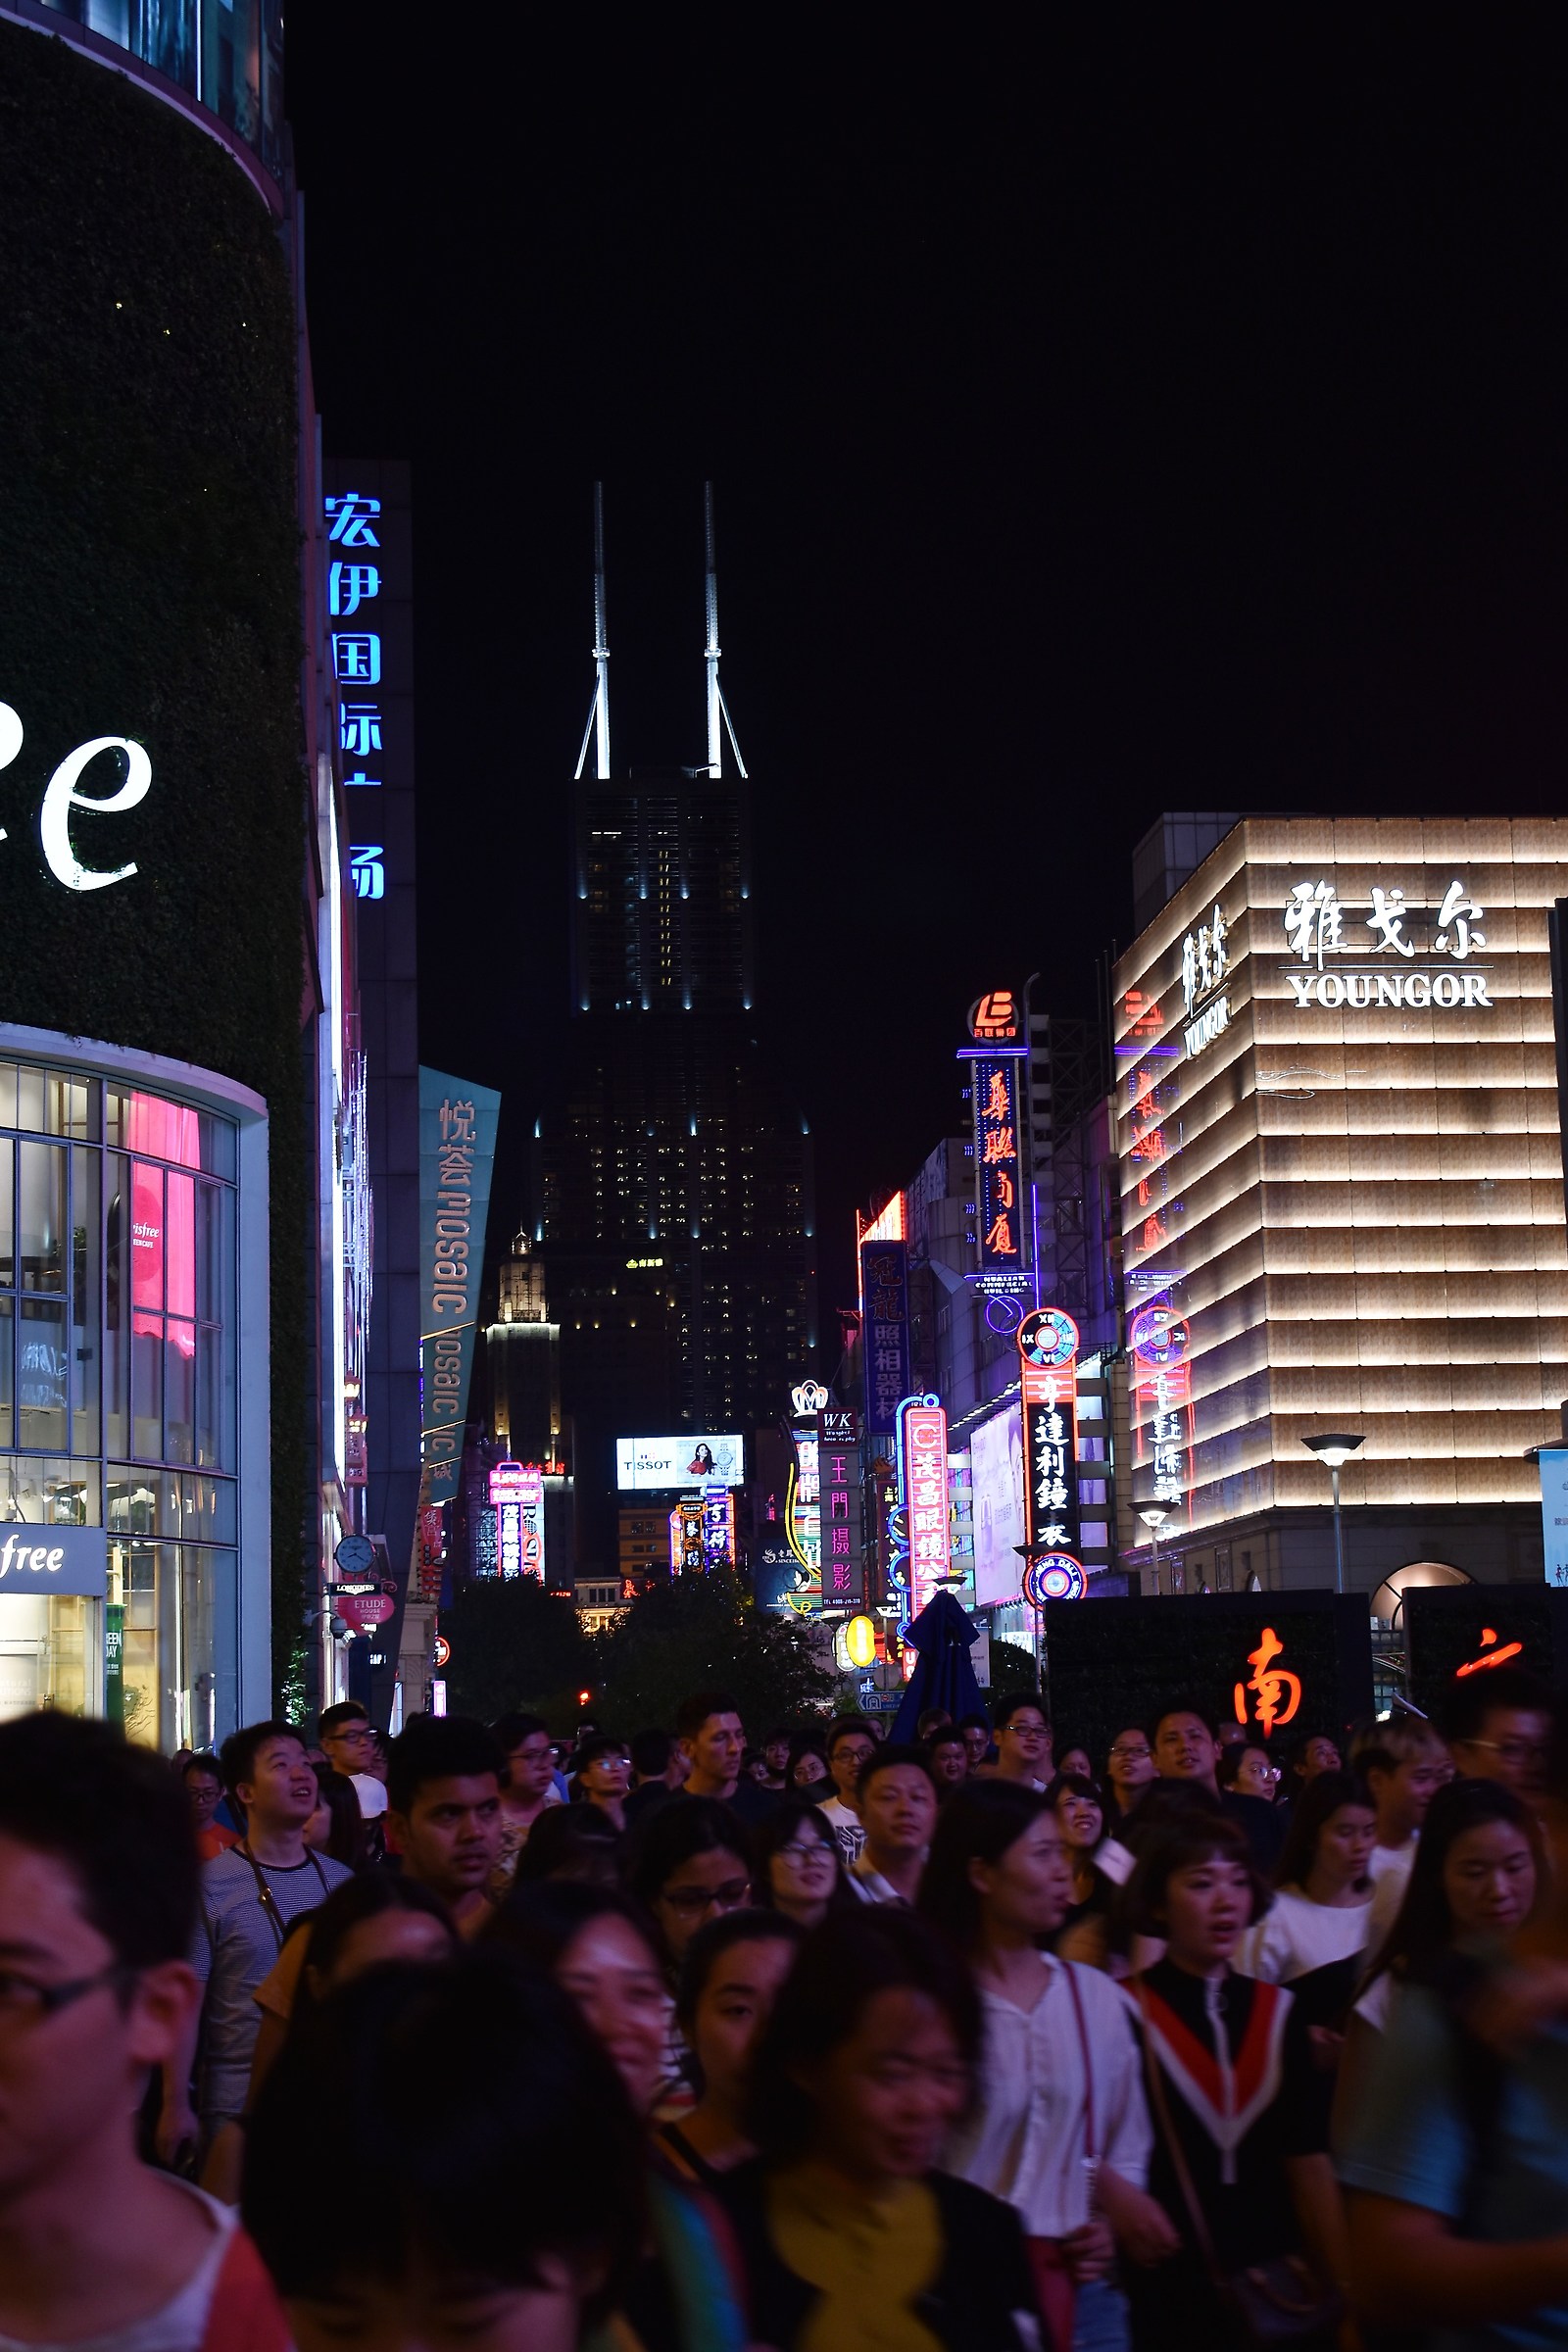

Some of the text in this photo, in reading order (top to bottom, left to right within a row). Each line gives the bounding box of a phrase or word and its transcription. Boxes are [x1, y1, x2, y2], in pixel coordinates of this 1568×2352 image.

[1284, 880, 1487, 970] 雅戈尔
[1286, 974, 1493, 1008] YOUNGOR
[1184, 996, 1230, 1060] YOUNGOR
[133, 1222, 160, 1238] isfree
[432, 1191, 471, 1314] mosaic
[623, 1460, 671, 1471] TISSOT
[0, 1534, 65, 1579] free
[354, 1598, 386, 1609] ETUDE
[1234, 1628, 1301, 1740] 南
